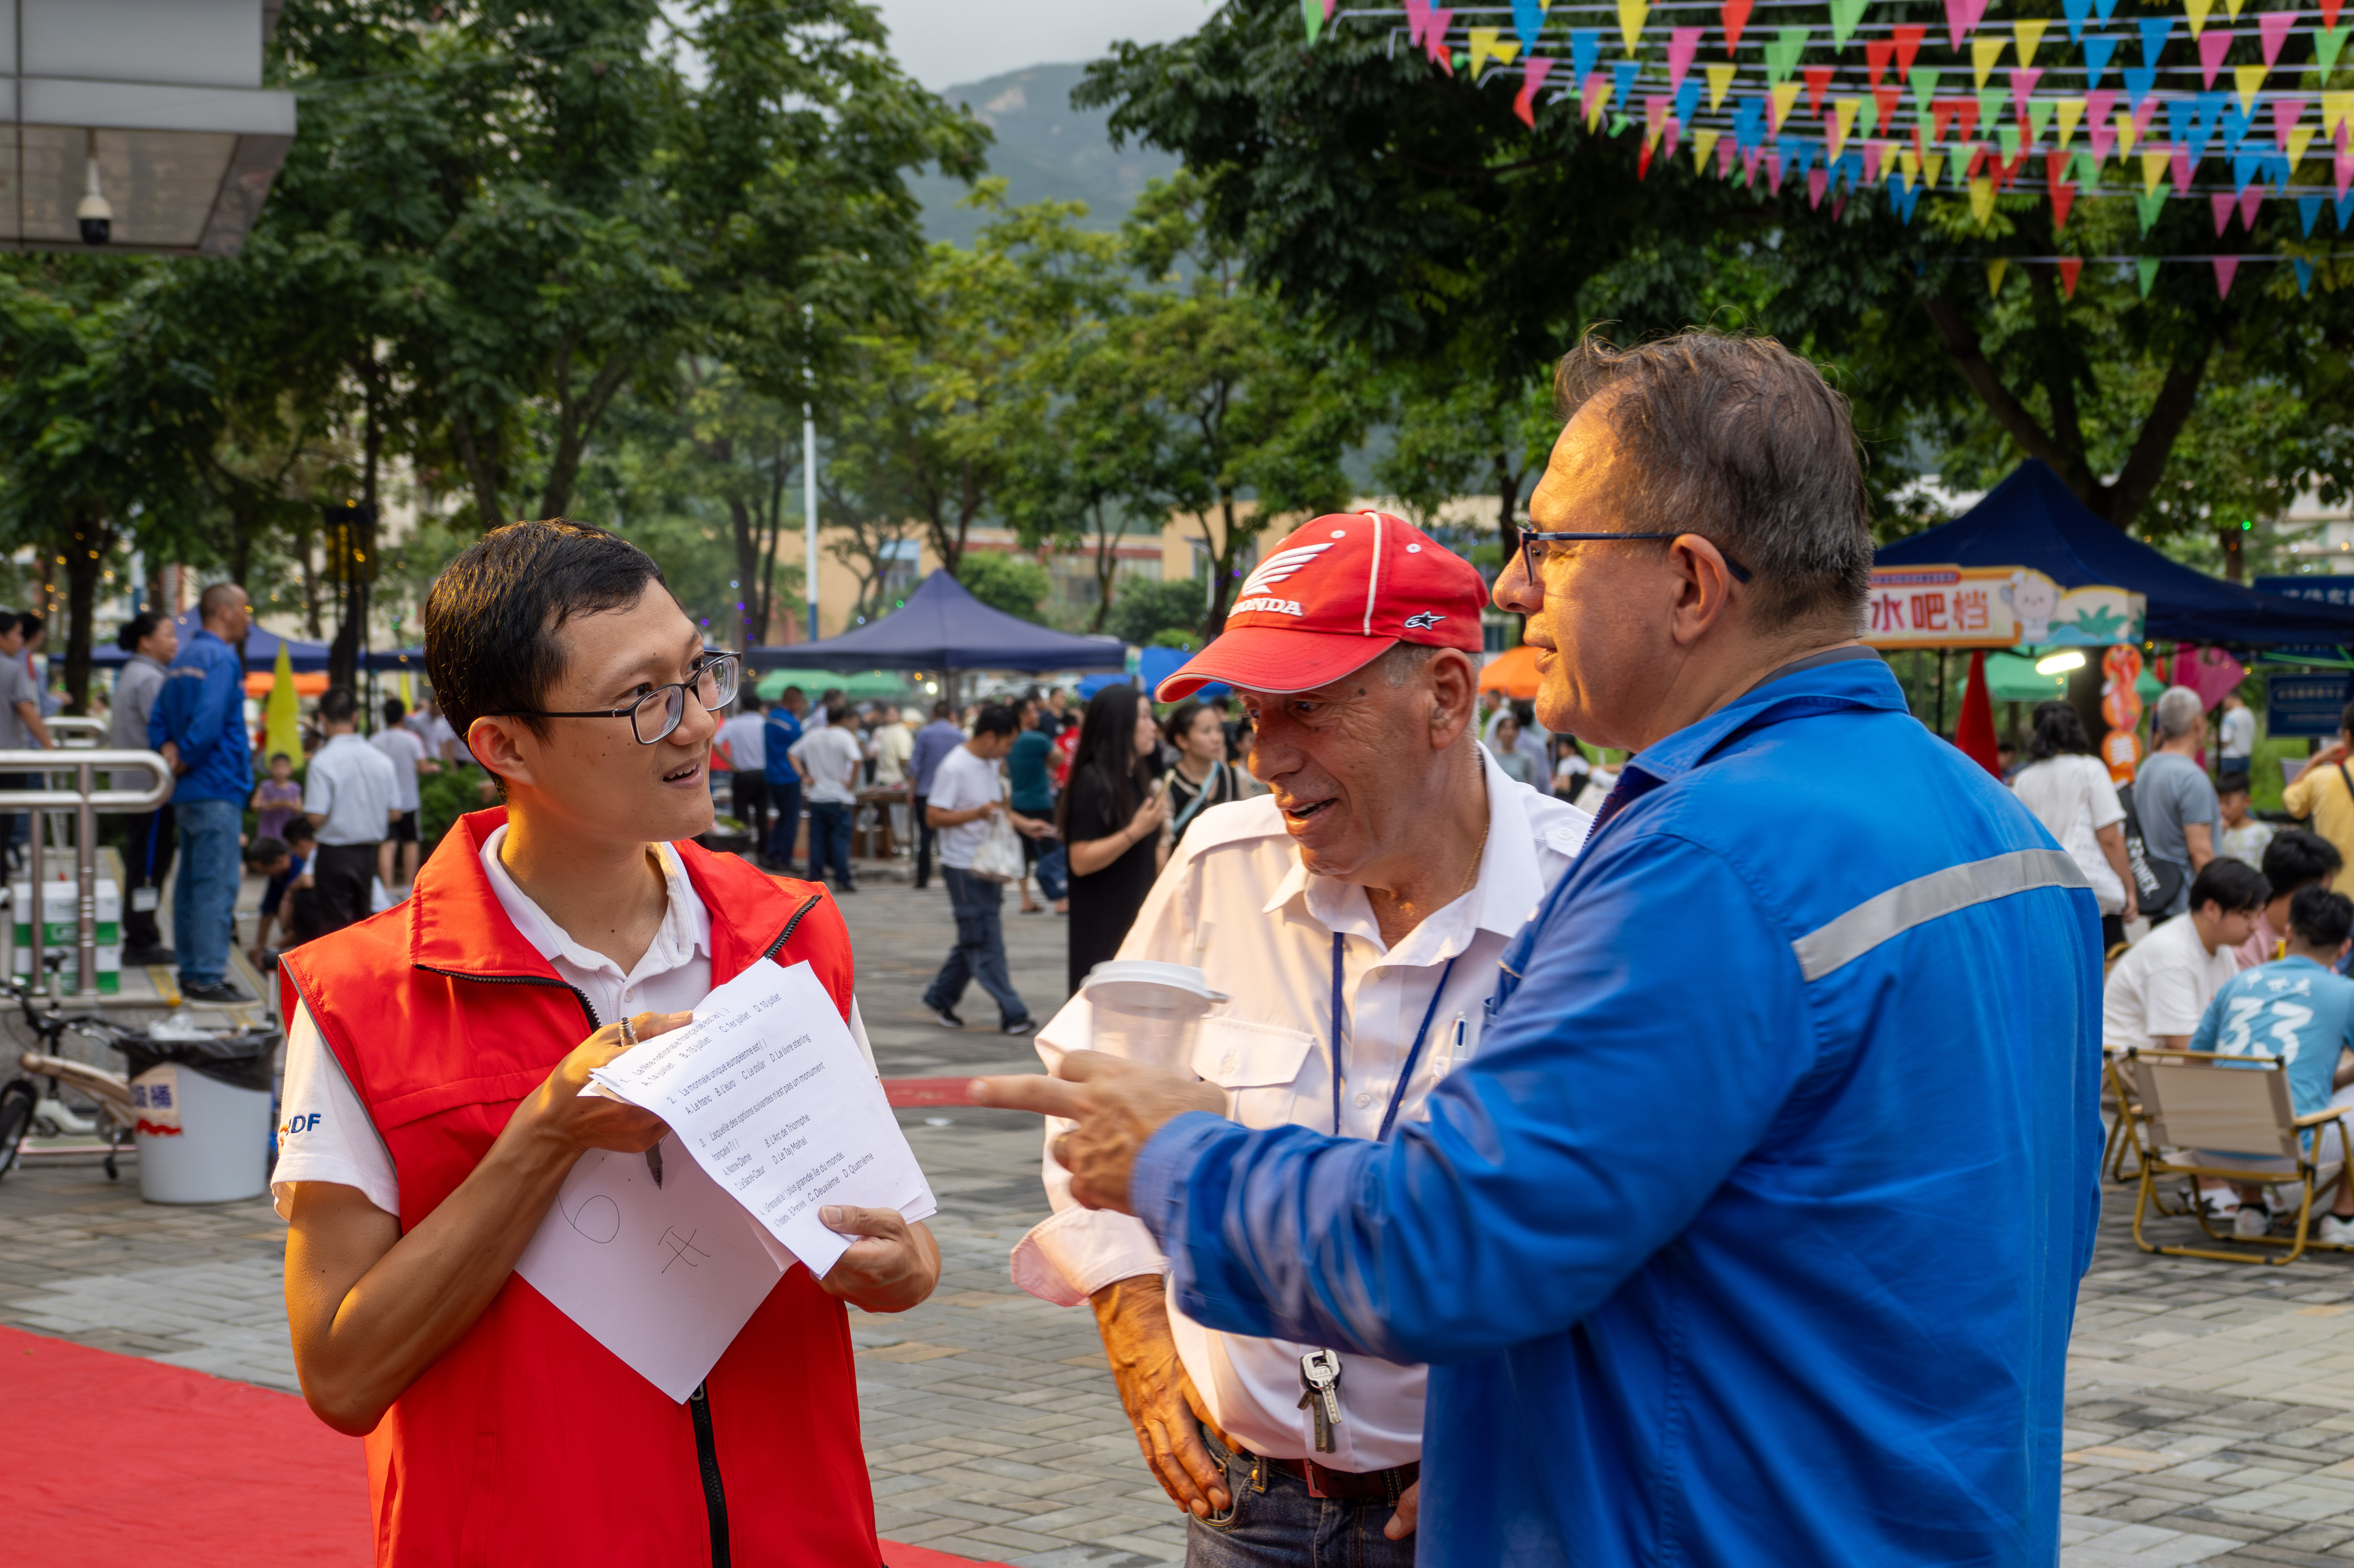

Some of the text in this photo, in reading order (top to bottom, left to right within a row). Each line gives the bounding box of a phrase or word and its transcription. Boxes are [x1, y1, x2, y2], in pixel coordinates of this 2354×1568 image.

[639, 1061, 656, 1070] fête
[652, 1041, 681, 1061] nationale
[676, 1023, 705, 1042] française
[702, 1017, 714, 1025] est
[654, 1062, 676, 1077] juillet
[692, 1036, 712, 1051] juillet
[725, 1020, 737, 1028] 1er
[733, 1011, 751, 1026] juillet
[759, 1000, 769, 1009] 10
[766, 993, 782, 1007] juillet
[2215, 996, 2314, 1070] 33
[678, 1088, 690, 1096] La
[687, 1074, 711, 1092] monnaie
[709, 1064, 727, 1078] unique
[725, 1047, 753, 1068] européenne
[752, 1042, 760, 1053] est
[685, 1033, 811, 1115] A. Le franc B. L'euro C. Le dollar D. La livre sterling
[699, 1061, 825, 1148] 3. Laquelle des options suivantes n'est pas un monument
[711, 1145, 730, 1161] français
[726, 1153, 752, 1173] Notre-Dame
[764, 1138, 771, 1148] B.
[769, 1132, 781, 1145] L'Arc
[780, 1128, 788, 1137] de
[785, 1114, 810, 1133] Triomphe
[772, 1155, 779, 1165] D.
[777, 1152, 785, 1161] Le
[782, 1145, 793, 1156] Taj
[790, 1135, 808, 1152] Mahal
[787, 1184, 797, 1197] plus
[796, 1172, 813, 1191] grande
[811, 1167, 820, 1177] île
[819, 1163, 827, 1173] du
[826, 1152, 845, 1168] monde.
[807, 1192, 815, 1202] C.
[813, 1176, 840, 1198] Deuxième
[842, 1168, 850, 1178] D.
[848, 1152, 873, 1174] Quatrième
